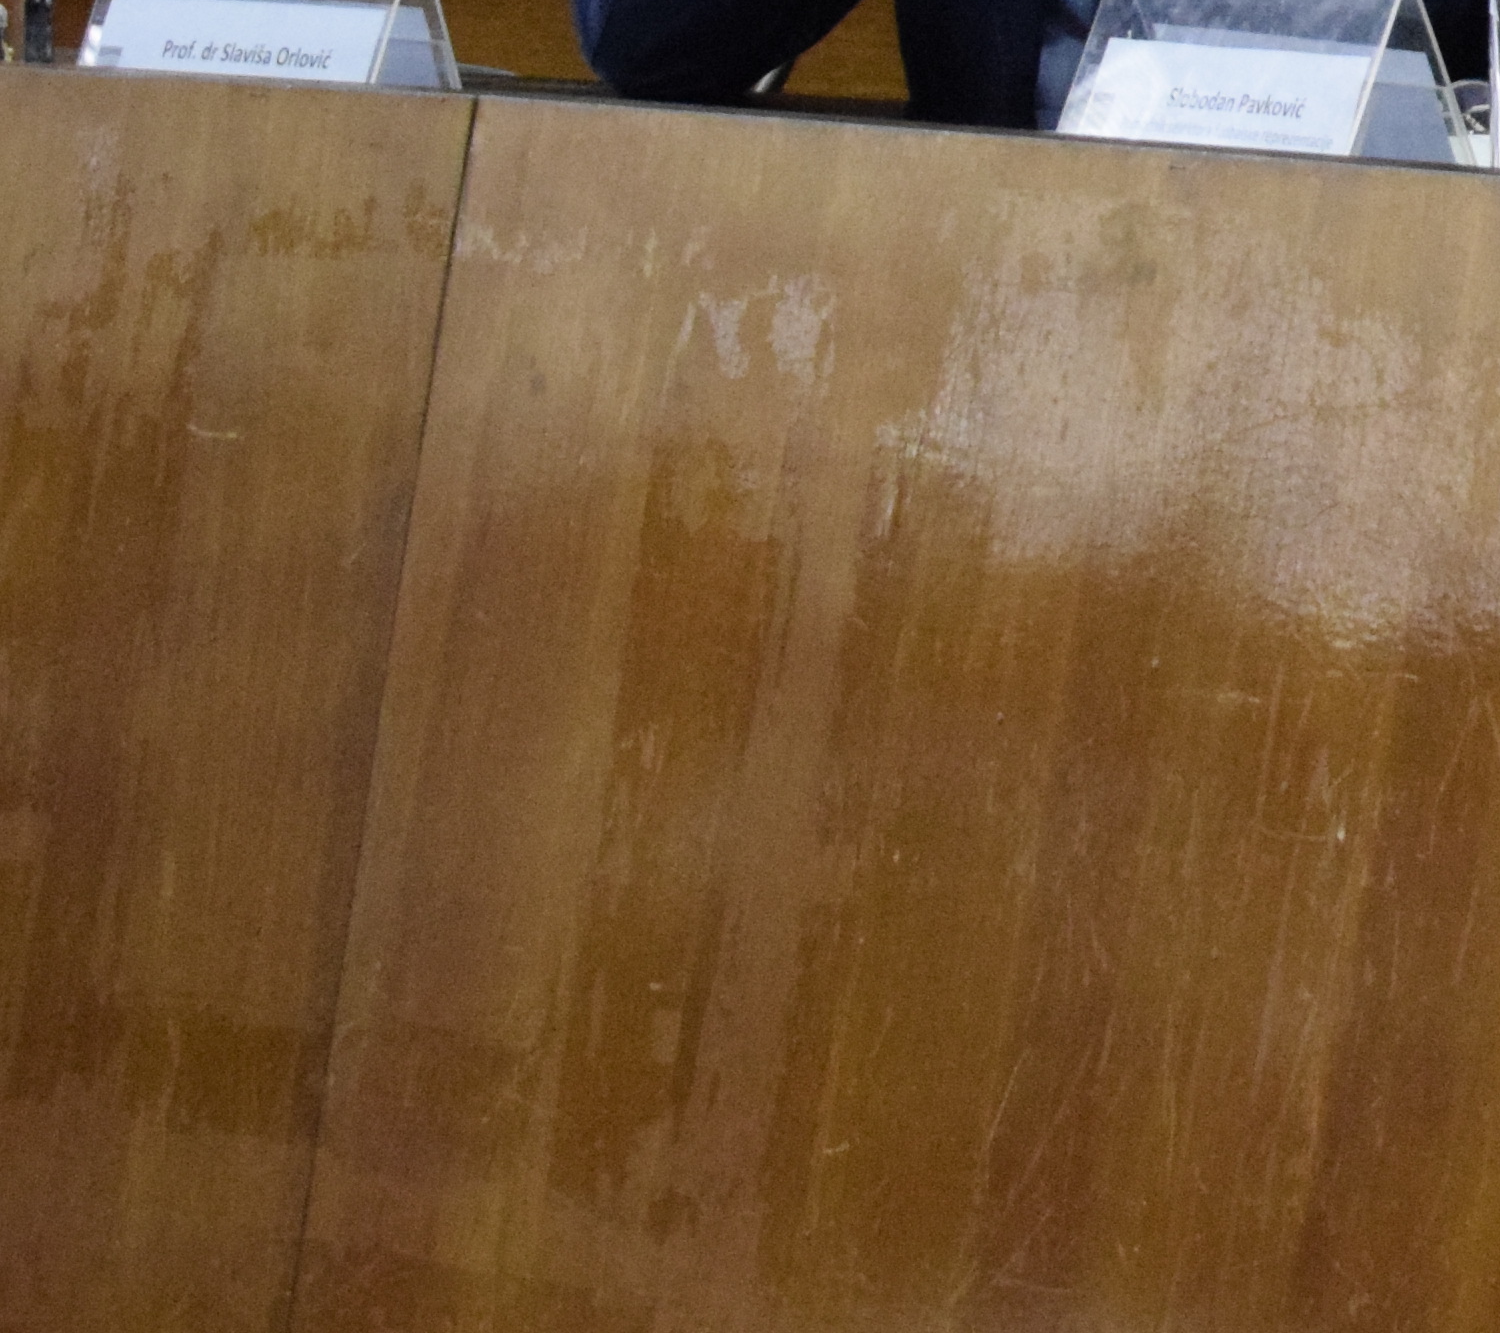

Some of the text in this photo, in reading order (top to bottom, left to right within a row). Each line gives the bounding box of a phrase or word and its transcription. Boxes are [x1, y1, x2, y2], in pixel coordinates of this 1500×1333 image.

[162, 39, 333, 70] Prof. dr Slaviša Orlović
[1166, 87, 1307, 119] Slobodan Pavković
